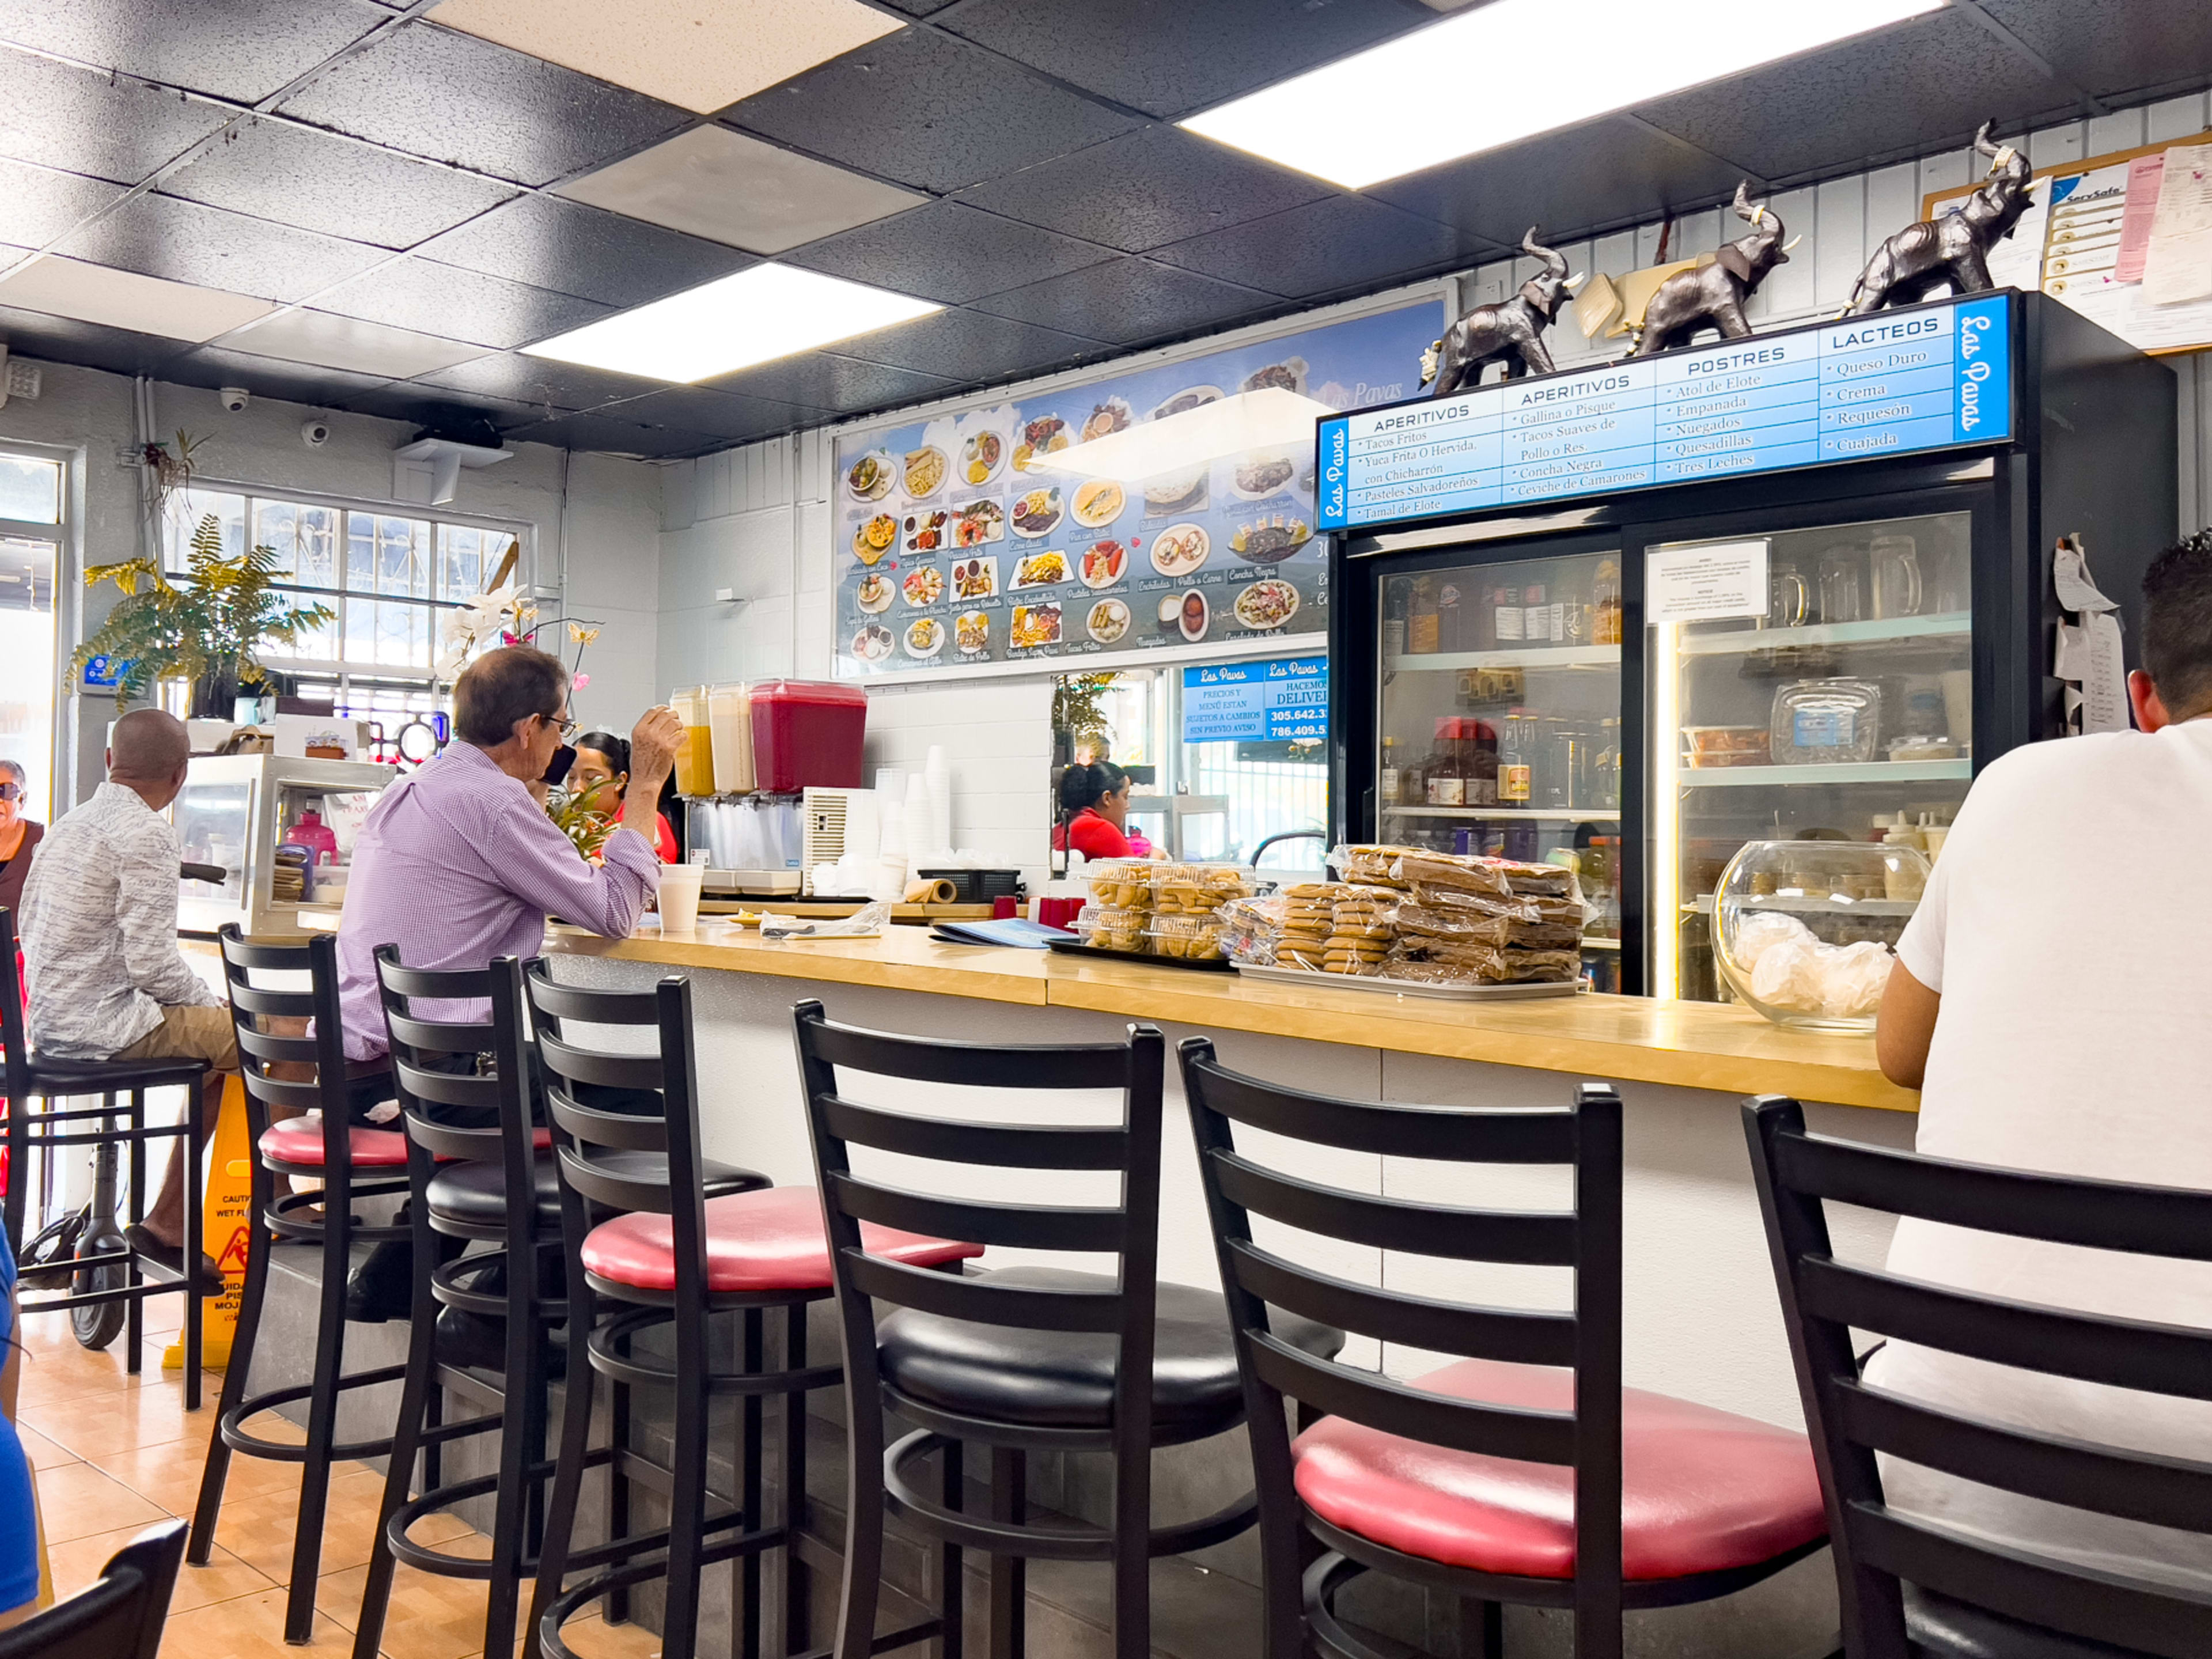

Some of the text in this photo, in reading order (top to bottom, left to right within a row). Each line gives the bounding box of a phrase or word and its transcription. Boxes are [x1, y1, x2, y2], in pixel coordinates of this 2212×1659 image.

[1833, 318, 1938, 349] LACTEOS
[1688, 347, 1785, 375] POSTRES
[1837, 352, 1926, 376] Queso Duro
[1961, 316, 1991, 431] Las Pavas
[1354, 382, 1403, 406] Pavas
[1521, 376, 1629, 405] APERITIVOS
[1676, 375, 1761, 398] Atol de Elote
[1837, 384, 1885, 401] Crema
[1521, 410, 1561, 425] Gallina
[1576, 402, 1615, 415] Pisque
[1676, 396, 1747, 417] Empanada
[1838, 404, 1910, 425] Requesón
[1374, 405, 1469, 432] APERITIVOS
[1676, 418, 1741, 436] Nuegados
[1520, 418, 1615, 443] Tacos Suaves de
[1366, 432, 1427, 450] Tacos Fritos
[1675, 434, 1752, 456] Quesadillas
[1837, 433, 1897, 451] Cuajada
[1365, 454, 1389, 467] Yuca
[1393, 450, 1416, 463] Frita
[1419, 448, 1427, 457] O
[1521, 449, 1550, 461] Pollo
[1564, 443, 1588, 454] Res.
[1325, 428, 1344, 517] Las Pavas
[1520, 459, 1602, 479] Concha Negra
[1675, 454, 1753, 474] Tres Leches
[1365, 465, 1443, 484] con Chicharrón
[1518, 470, 1645, 495] Ceviche de Camarones
[1365, 478, 1478, 501] Pasteles Salvadoreños
[1364, 499, 1441, 518] Tamal de Elote
[1200, 668, 1247, 683] Las Pavas
[1269, 662, 1319, 677] Las Pavas
[1203, 690, 1234, 698] PRECIOS
[1186, 714, 1218, 723] SUJETOS
[1225, 711, 1260, 720] CAMBIOS
[1204, 725, 1232, 733] PREVIO
[1271, 725, 1327, 737] 786.409.5
[215, 1302, 239, 1310] MOJ
